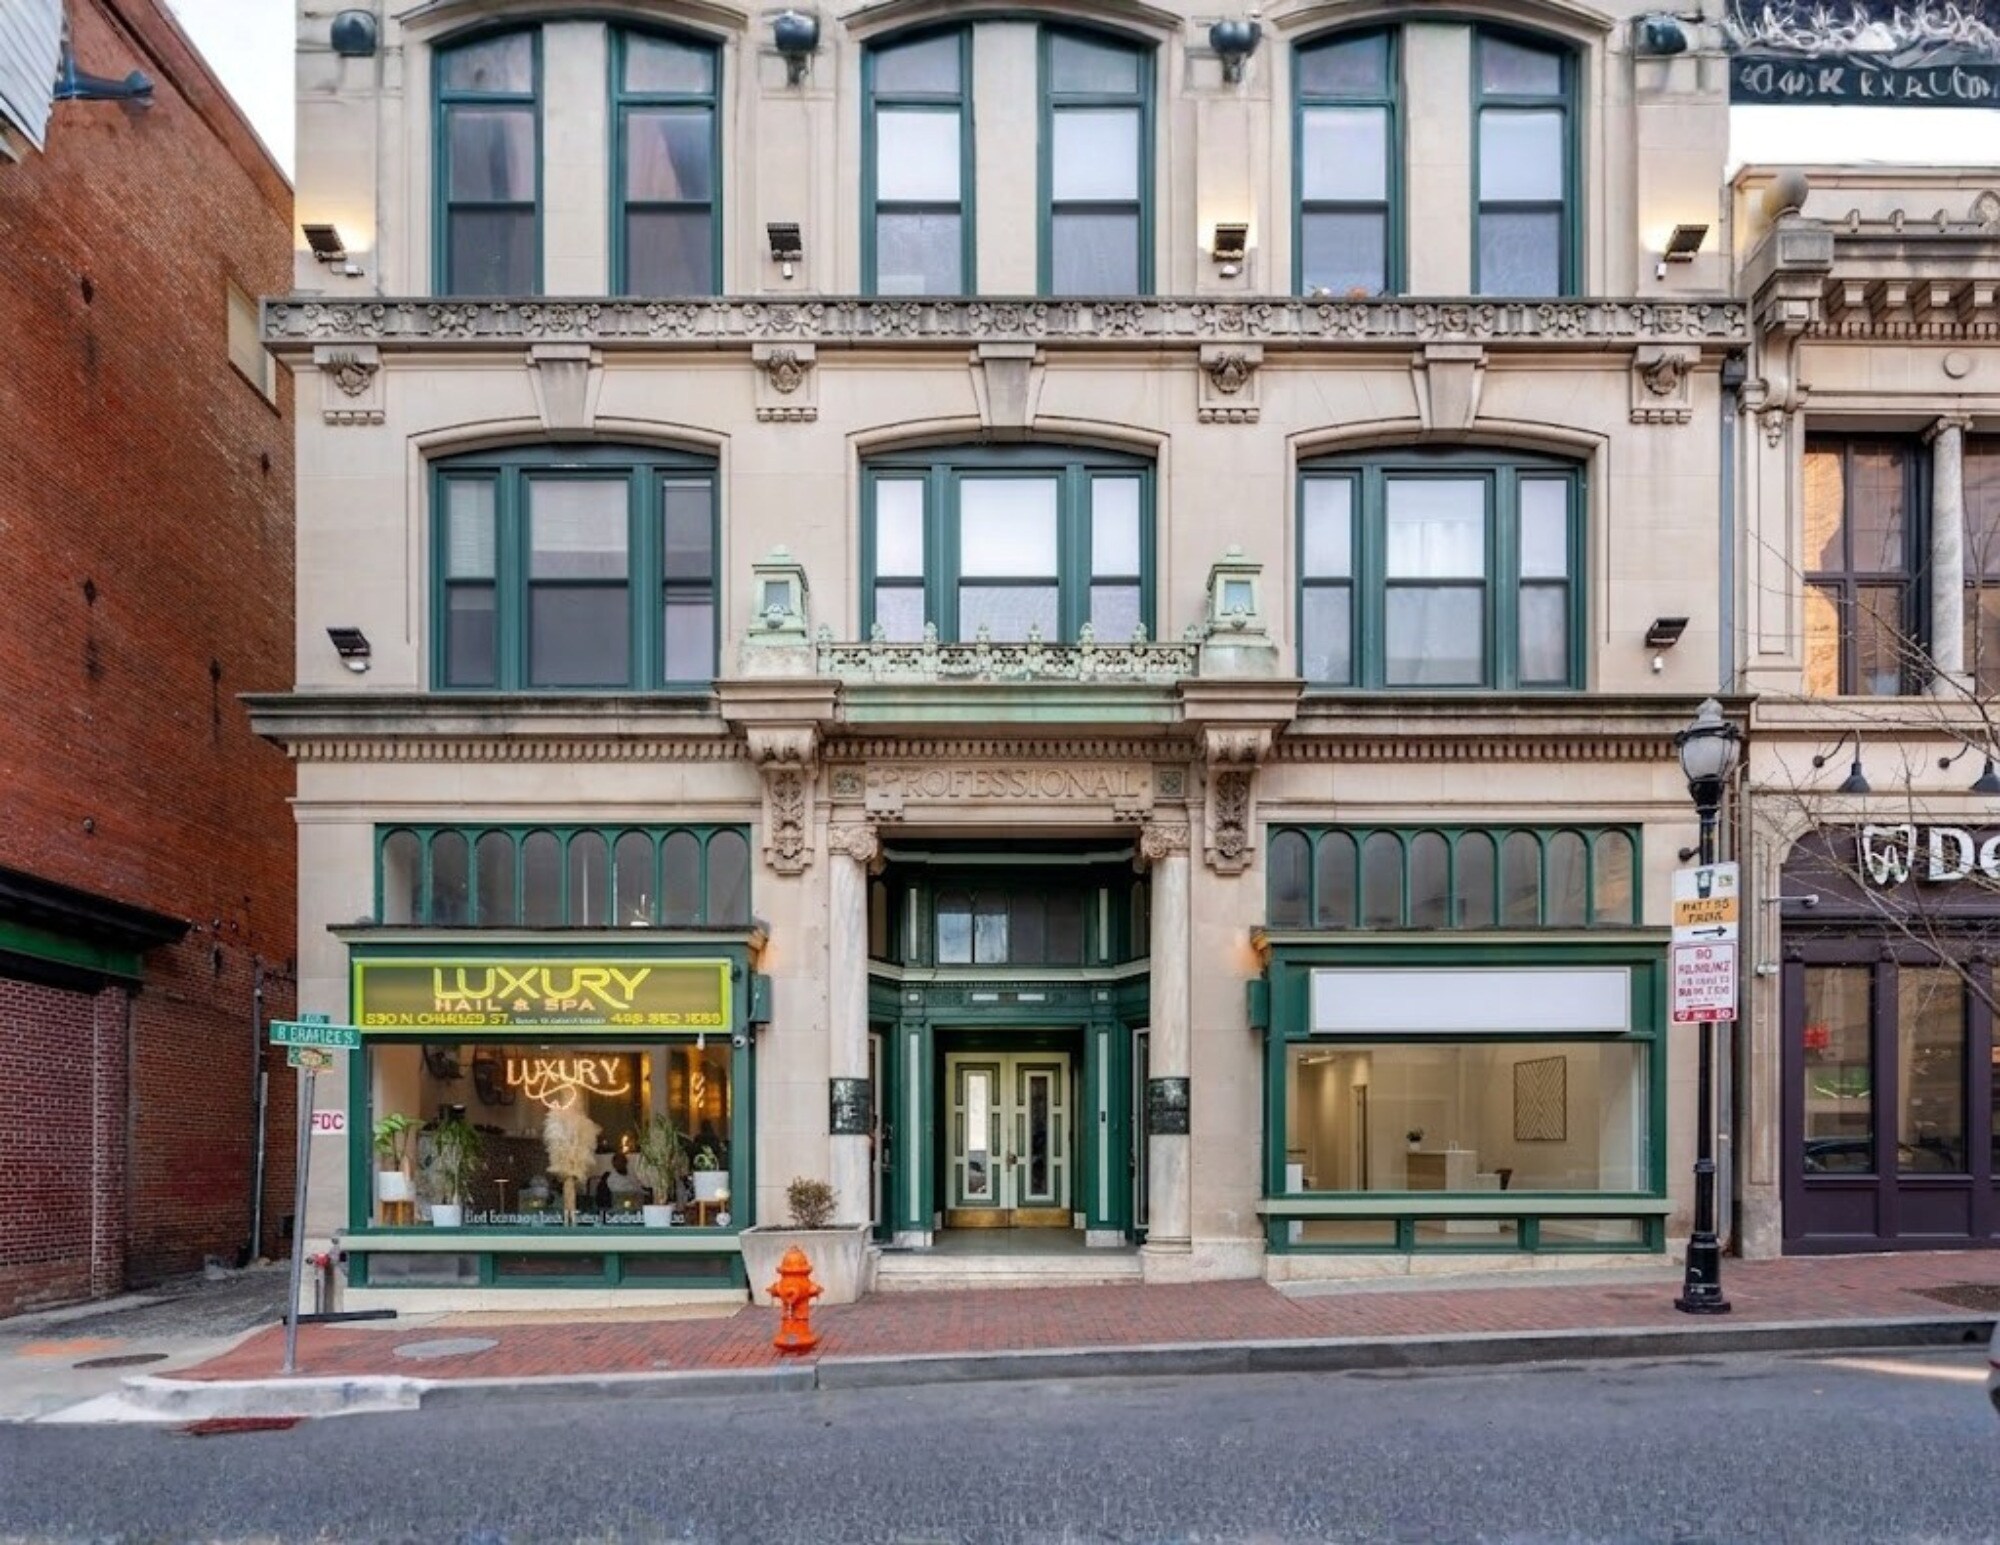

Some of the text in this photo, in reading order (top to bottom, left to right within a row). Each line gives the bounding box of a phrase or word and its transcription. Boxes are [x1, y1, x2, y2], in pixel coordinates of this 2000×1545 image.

[879, 768, 1140, 798] PROFESSIONAL
[433, 967, 651, 1009] LUXURY
[544, 997, 596, 1012] SPA
[507, 1058, 629, 1096] LUXURY
